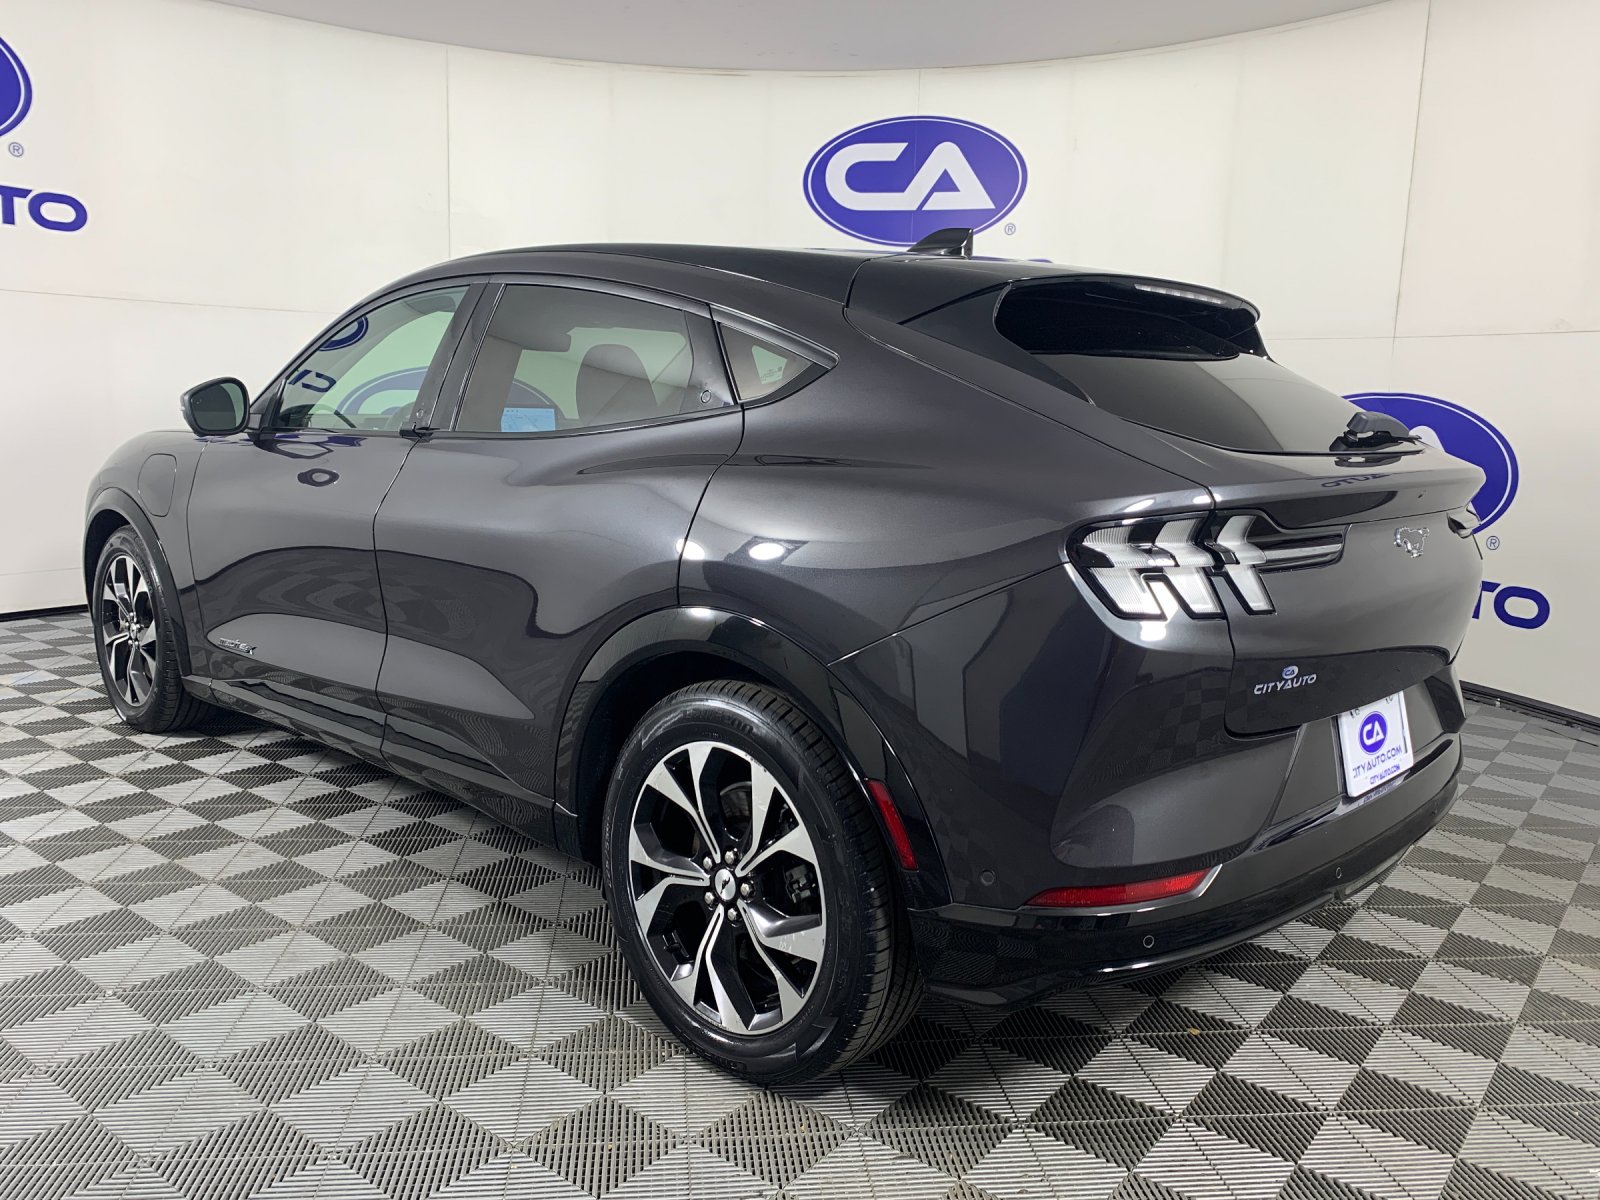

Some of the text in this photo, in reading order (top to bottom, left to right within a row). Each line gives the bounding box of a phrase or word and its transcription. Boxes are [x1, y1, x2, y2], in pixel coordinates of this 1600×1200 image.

[825, 141, 996, 211] CA
[1253, 673, 1317, 695] CITYAUTO
[1363, 720, 1384, 745] CA
